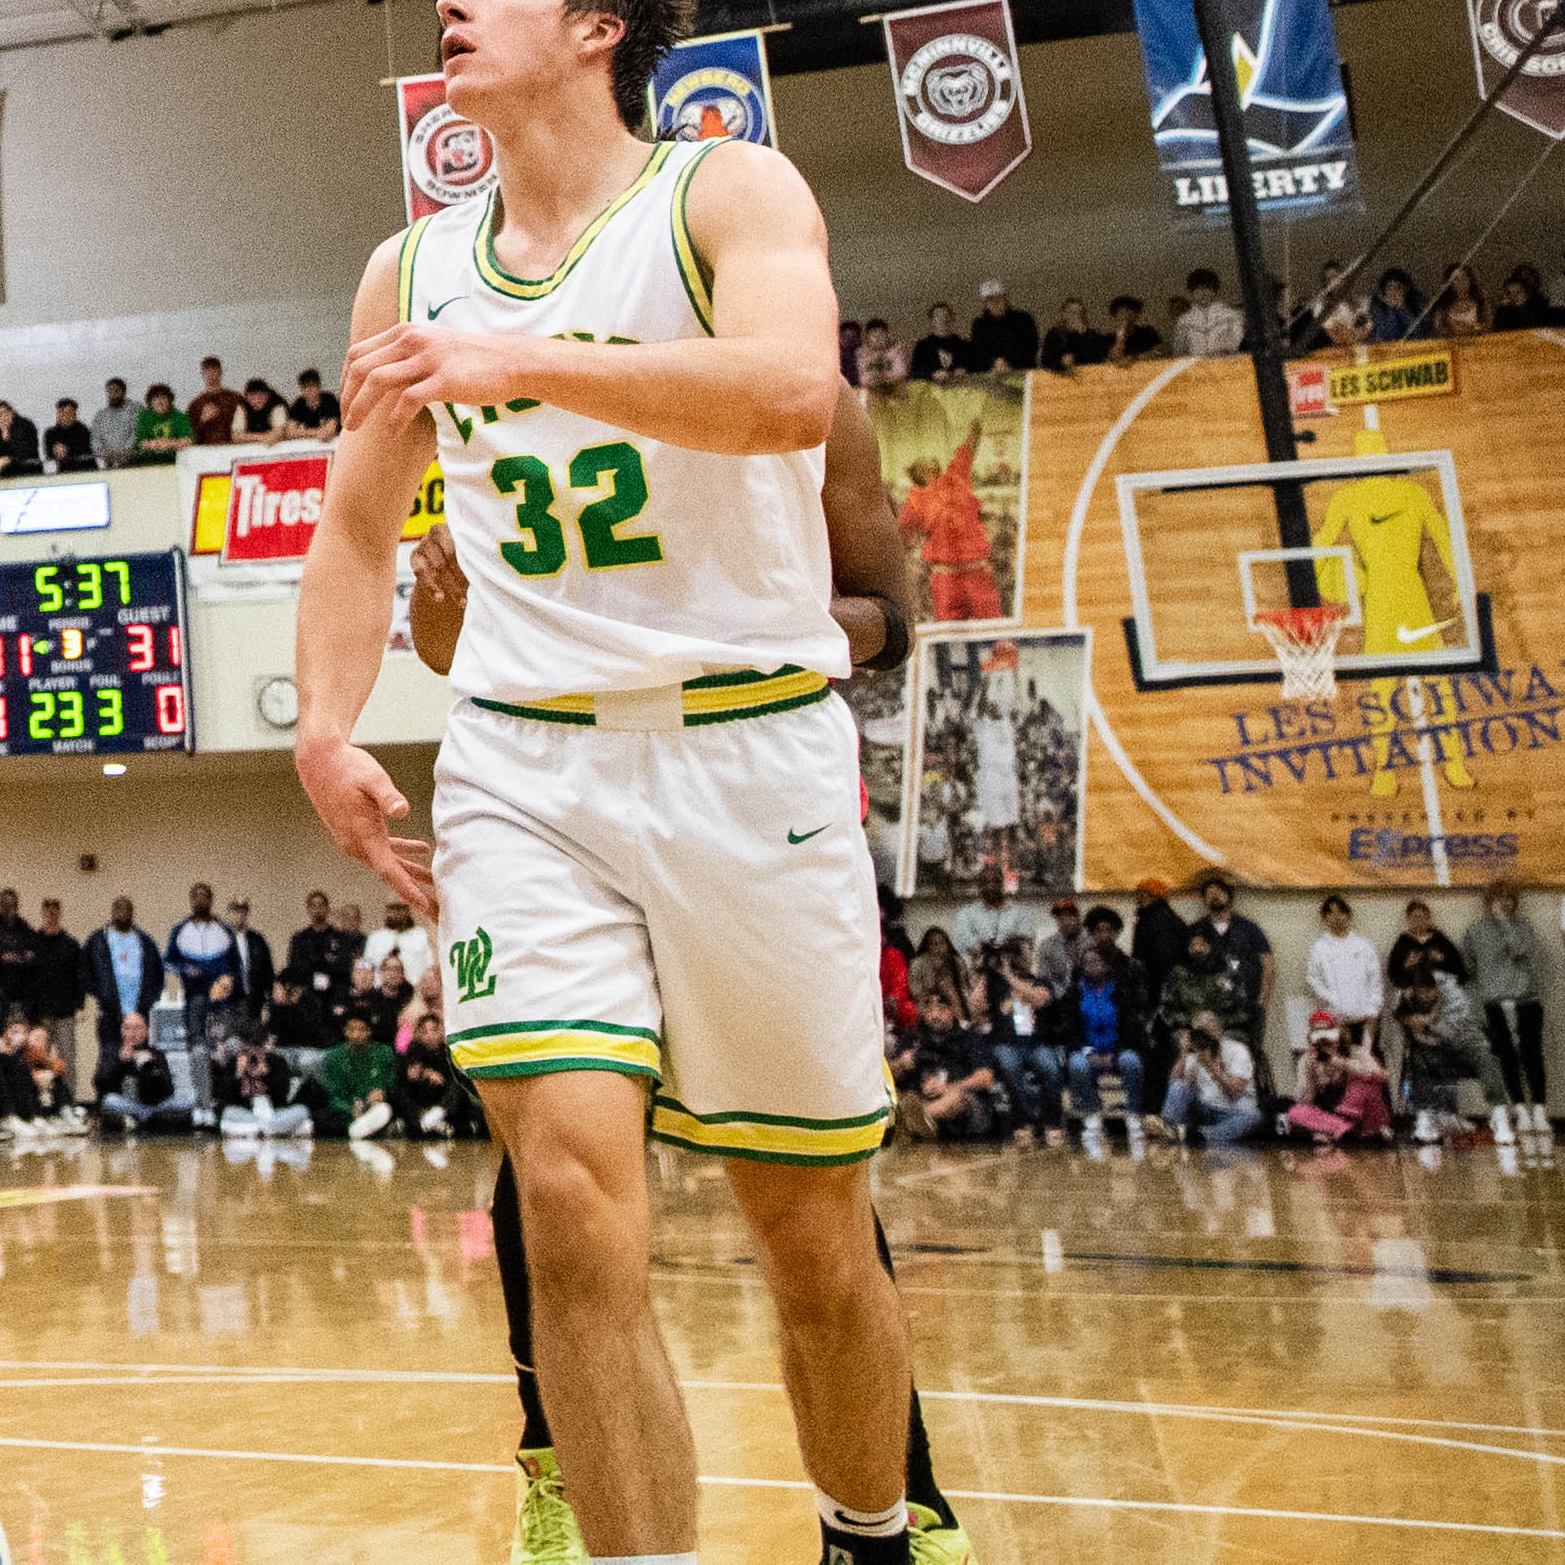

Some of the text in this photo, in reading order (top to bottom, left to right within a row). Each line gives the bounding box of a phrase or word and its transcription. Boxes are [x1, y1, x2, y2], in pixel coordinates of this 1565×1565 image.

[1331, 374, 1360, 398] LES
[1366, 361, 1449, 394] SCHWAB
[235, 475, 323, 538] Tires
[490, 441, 664, 577] 32
[117, 606, 171, 623] GUEST
[62, 628, 83, 660] 3
[126, 624, 180, 672] 31
[28, 676, 78, 691] PLAYER
[1230, 660, 1565, 746] LES SCHWA
[156, 684, 185, 733] 0
